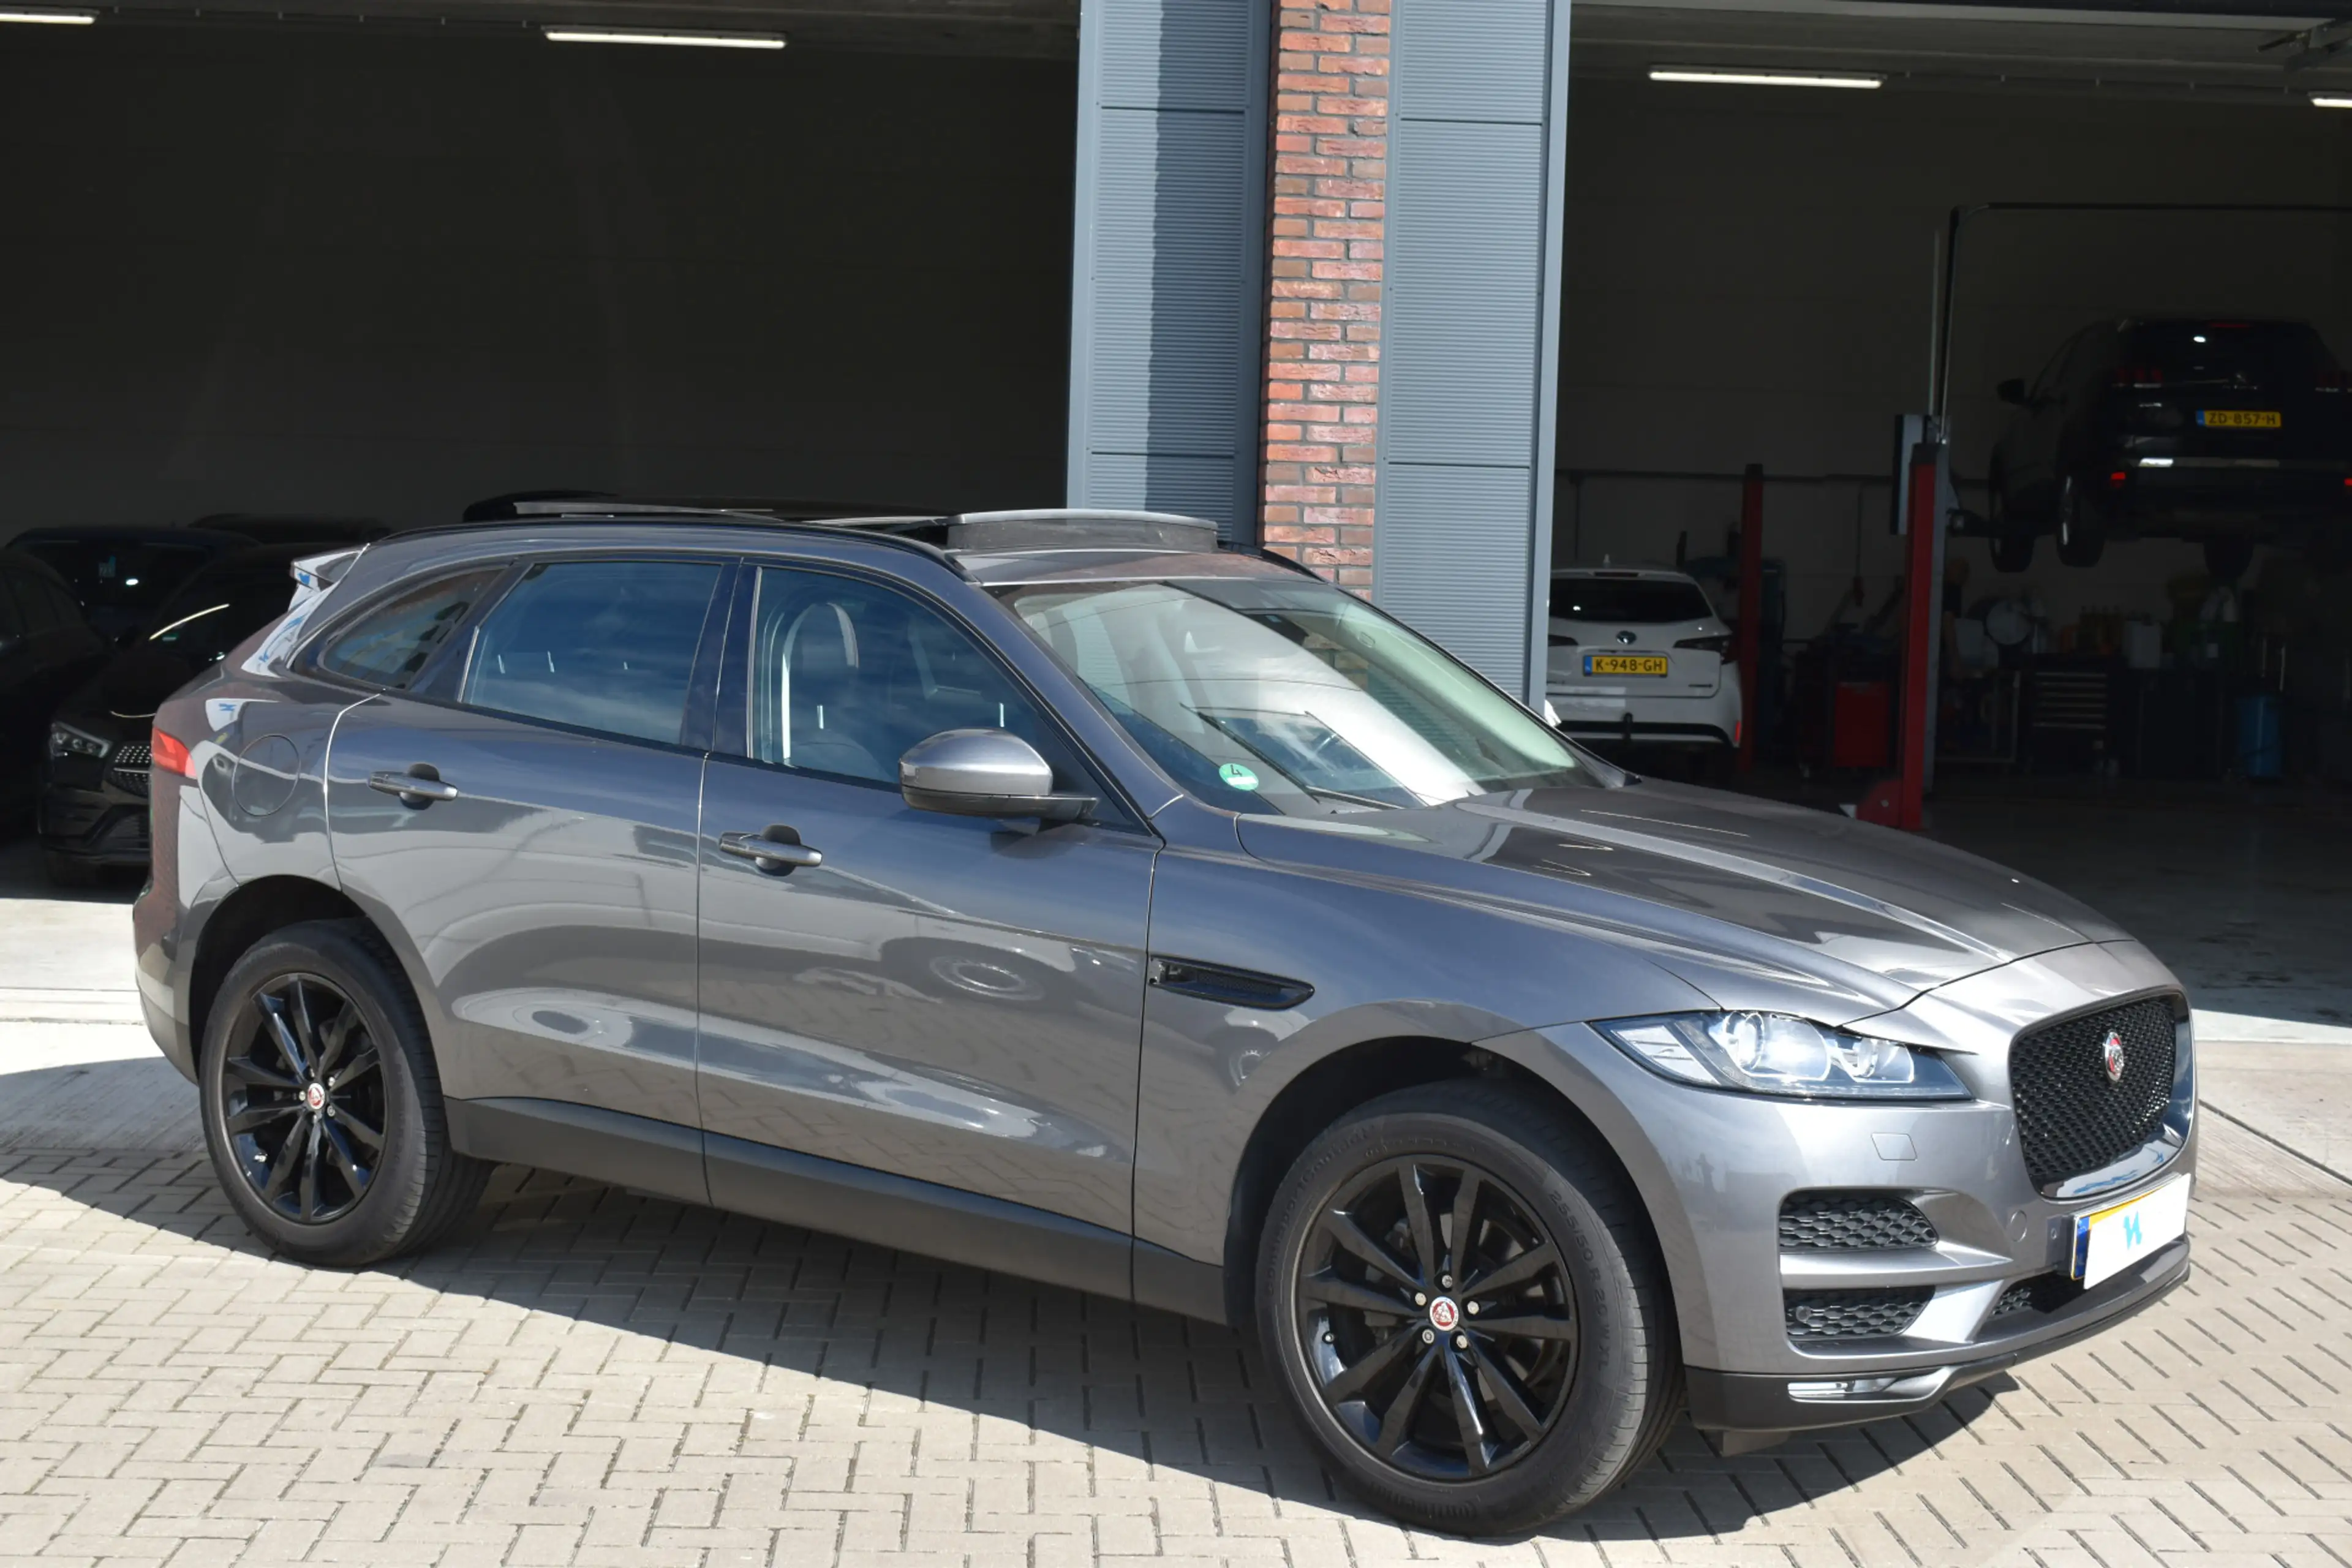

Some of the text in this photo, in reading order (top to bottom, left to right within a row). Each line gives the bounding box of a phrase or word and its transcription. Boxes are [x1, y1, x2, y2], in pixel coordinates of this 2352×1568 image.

[2209, 412, 2275, 424] ZD-857-H
[1596, 658, 1662, 672] K-948-GH
[1230, 764, 1242, 777] 4
[1548, 1191, 1594, 1262] 255/50
